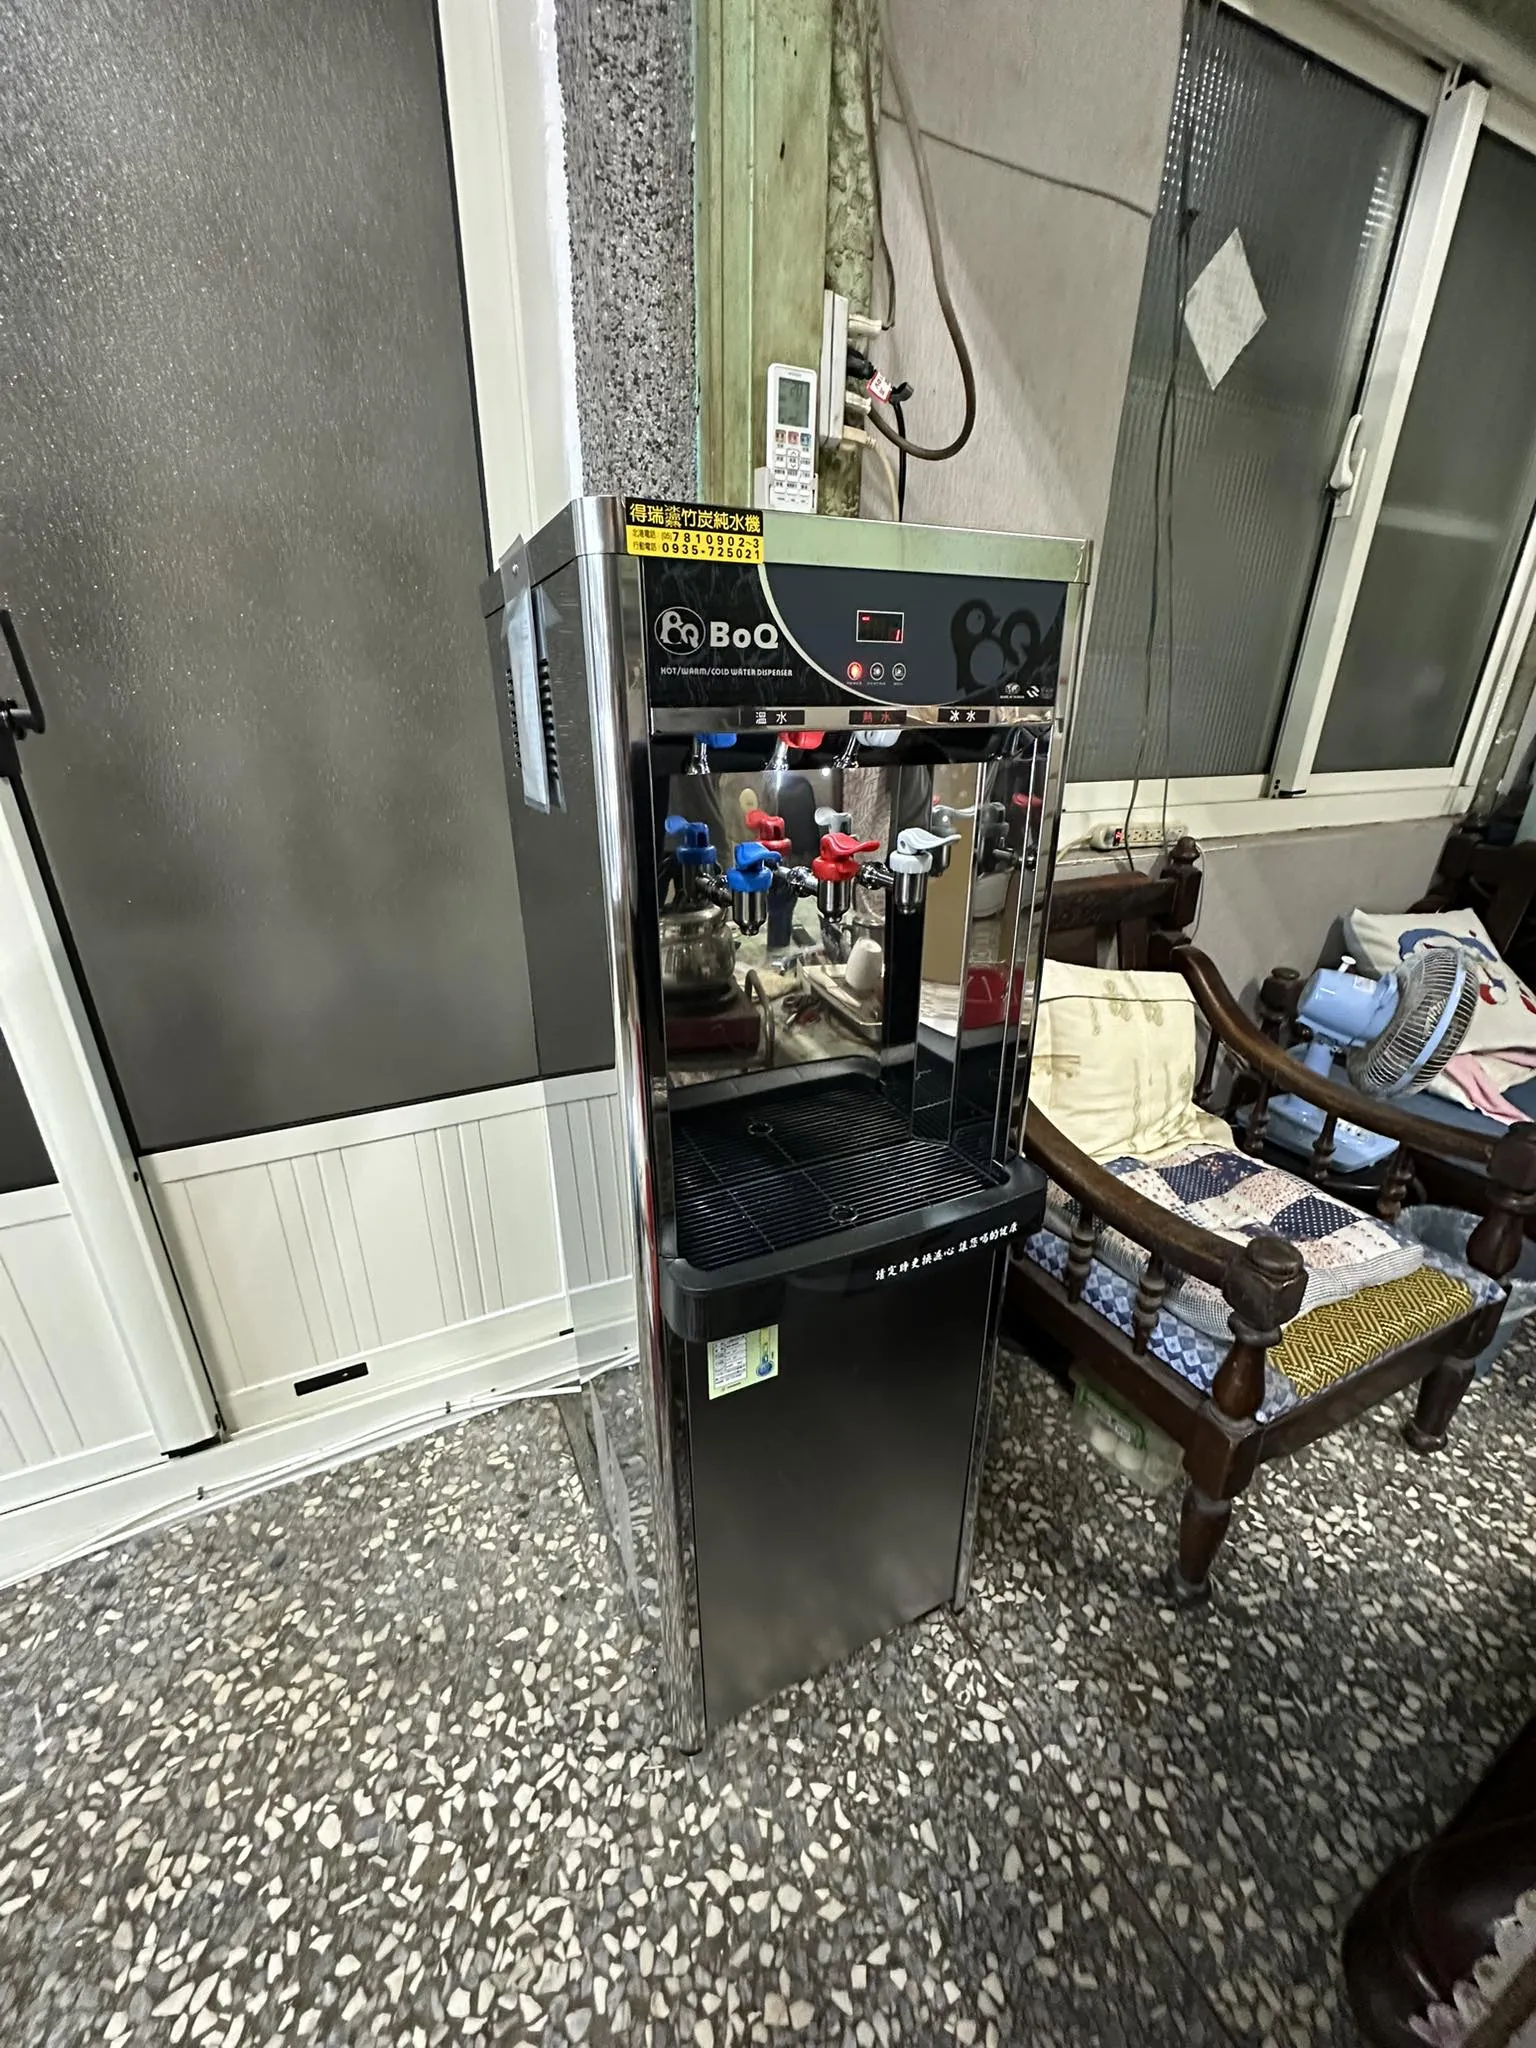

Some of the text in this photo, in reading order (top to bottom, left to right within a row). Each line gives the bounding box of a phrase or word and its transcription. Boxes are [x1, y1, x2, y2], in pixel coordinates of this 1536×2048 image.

[662, 543, 759, 559] 0935-725021
[710, 621, 779, 649] BoQ
[731, 668, 756, 676] WATER
[757, 668, 793, 677] DISPENSER
